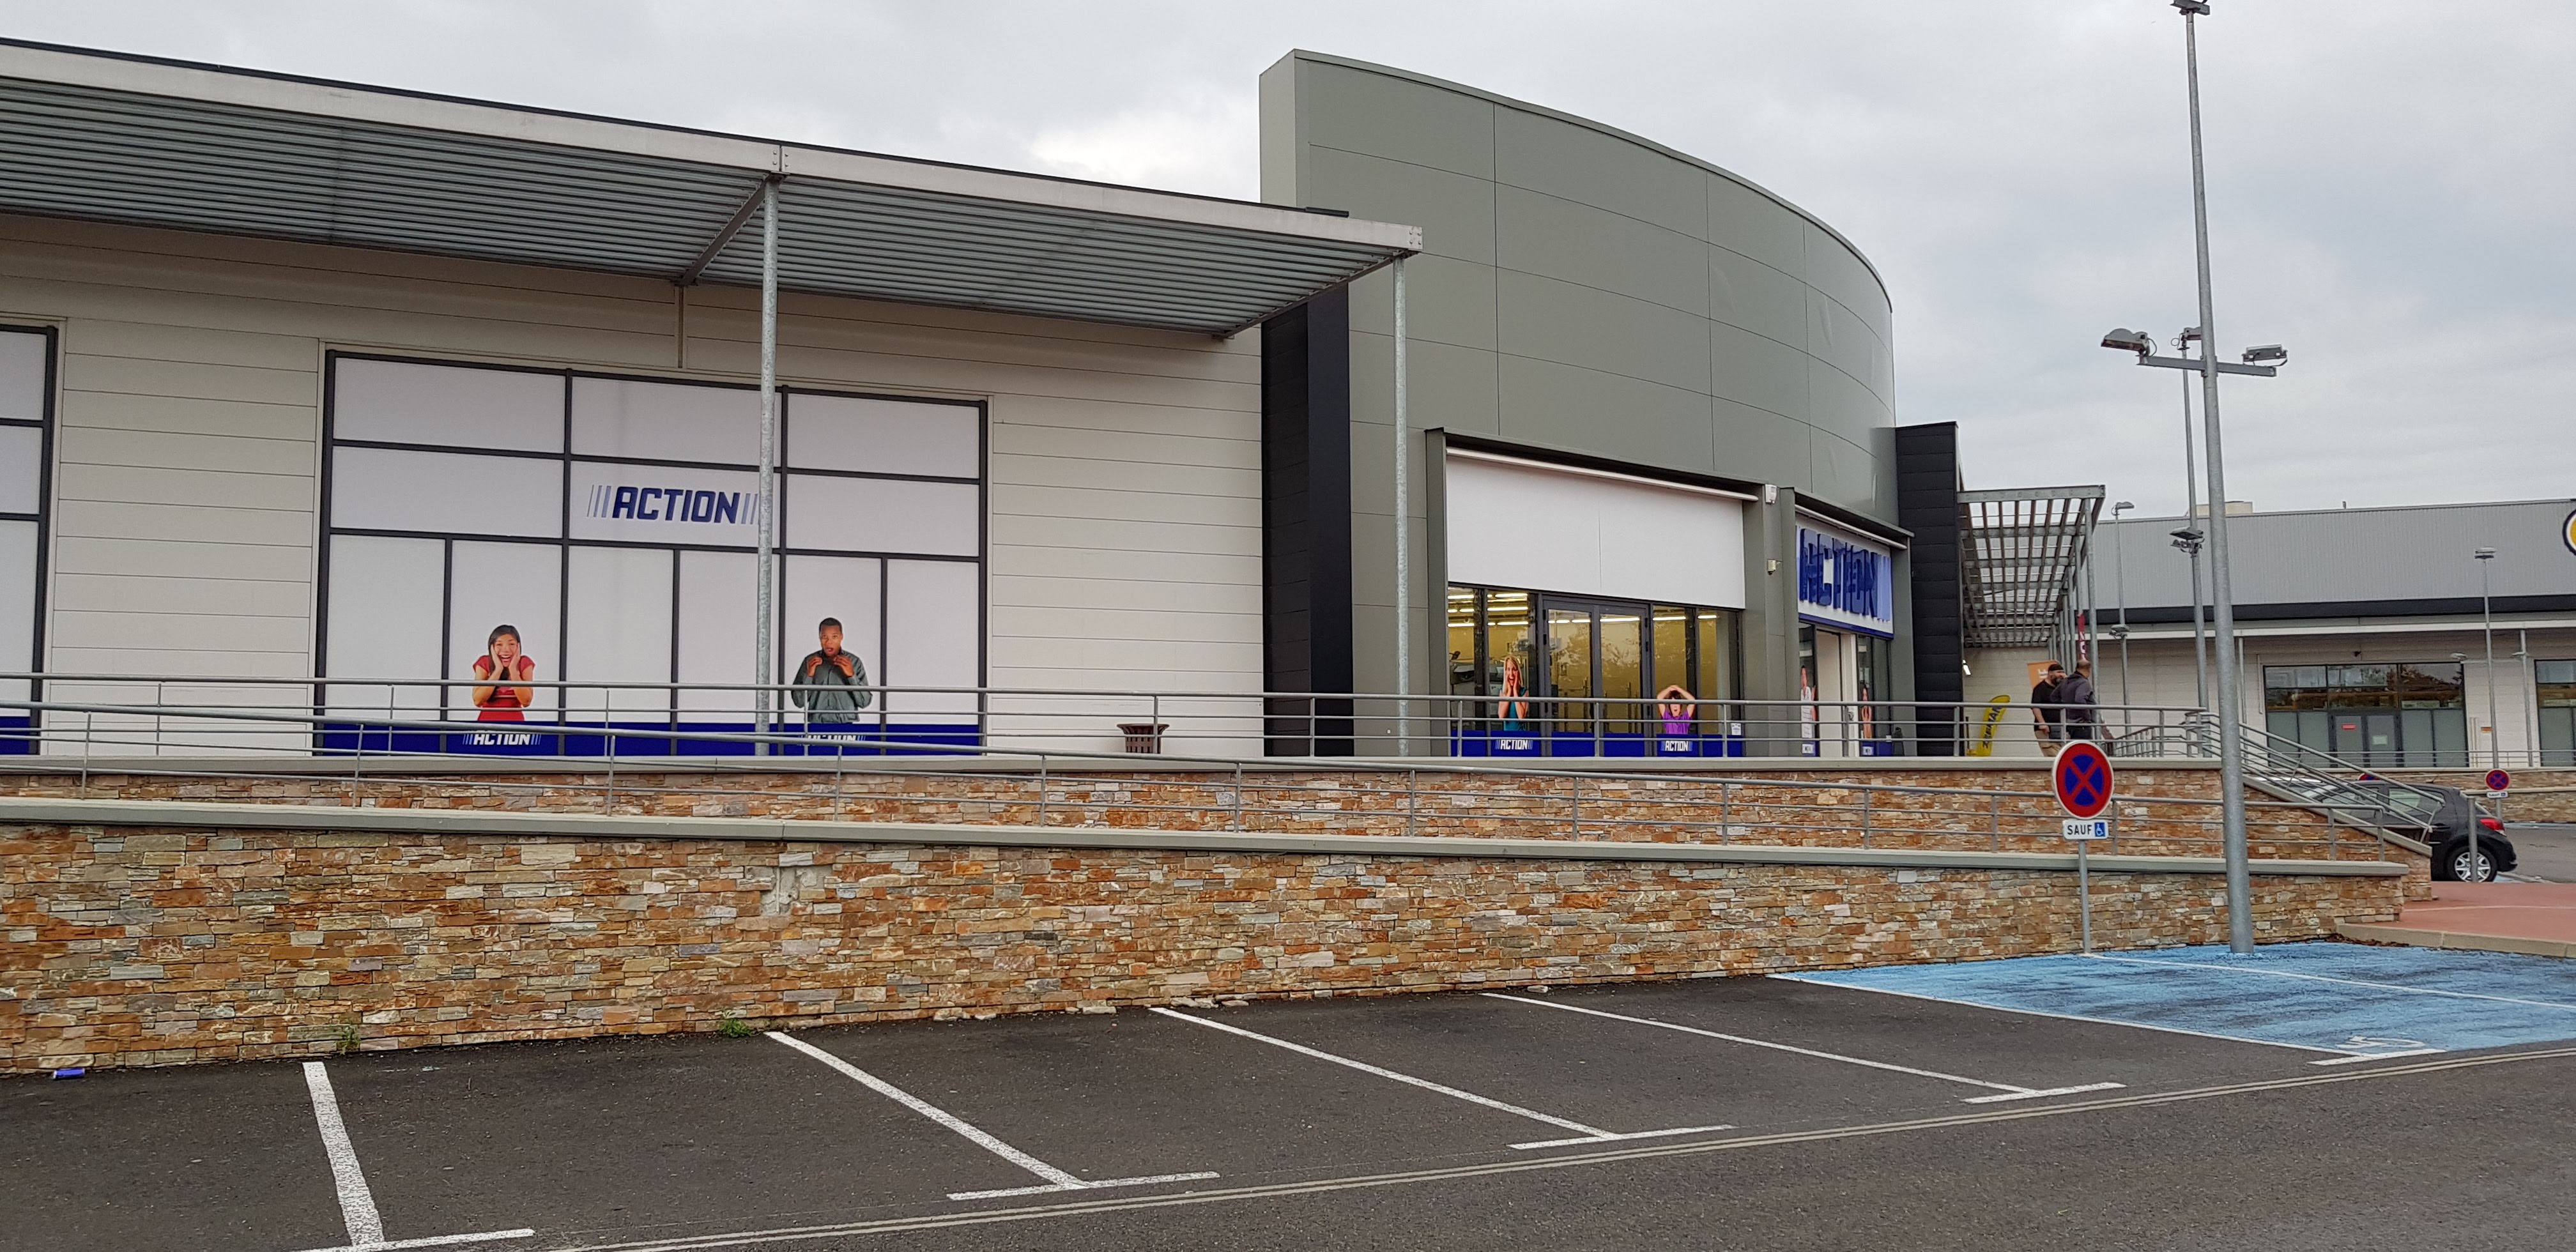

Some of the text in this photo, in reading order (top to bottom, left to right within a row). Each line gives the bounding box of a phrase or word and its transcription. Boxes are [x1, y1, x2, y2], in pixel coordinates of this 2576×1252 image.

[611, 486, 740, 524] ACTION
[1799, 528, 1878, 618] ACTION
[473, 730, 531, 745] ACTION
[1500, 740, 1528, 750] ACTION
[1665, 740, 1689, 751] ACTION
[2067, 825, 2092, 836] SAUF
